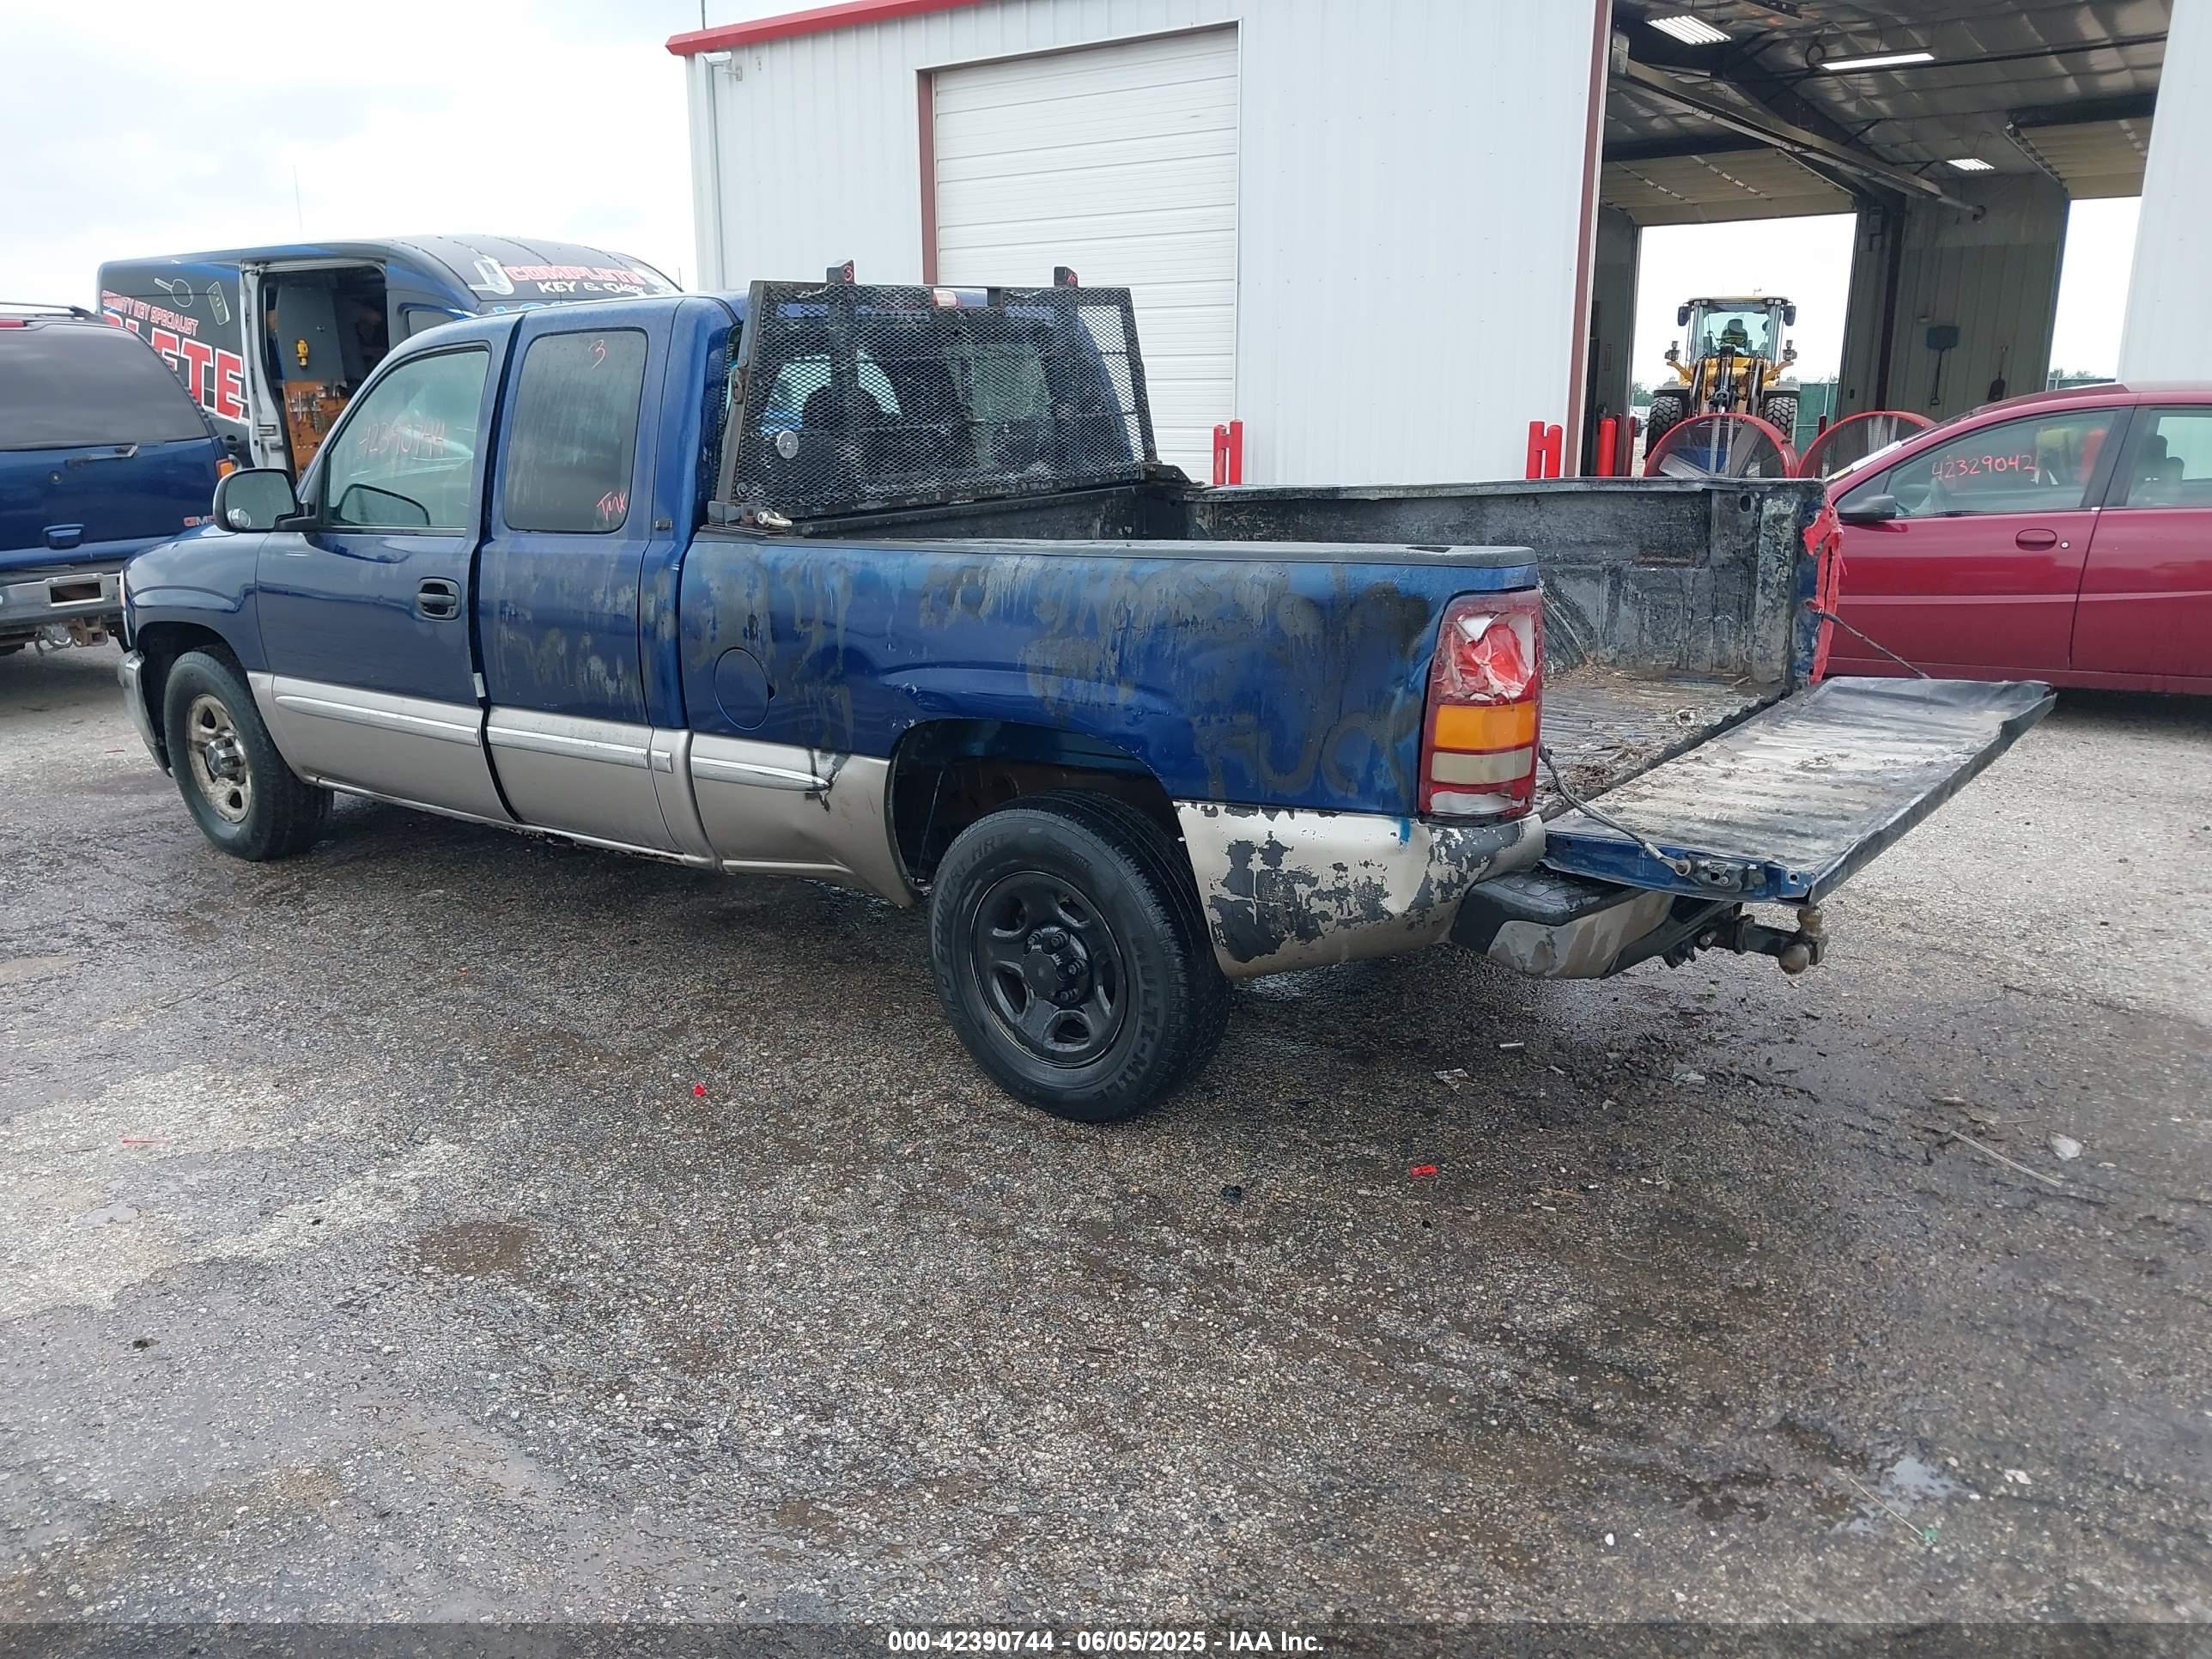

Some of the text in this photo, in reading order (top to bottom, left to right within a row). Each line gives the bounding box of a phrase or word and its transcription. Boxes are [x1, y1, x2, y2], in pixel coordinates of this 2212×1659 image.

[502, 265, 646, 285] COMPLETE
[843, 264, 854, 282] 3
[536, 281, 577, 294] KEY
[582, 282, 605, 291] &
[133, 300, 152, 321] KEY
[149, 305, 199, 337] SPECIALIST
[588, 339, 606, 369] 3
[1931, 453, 2037, 480] 42329042
